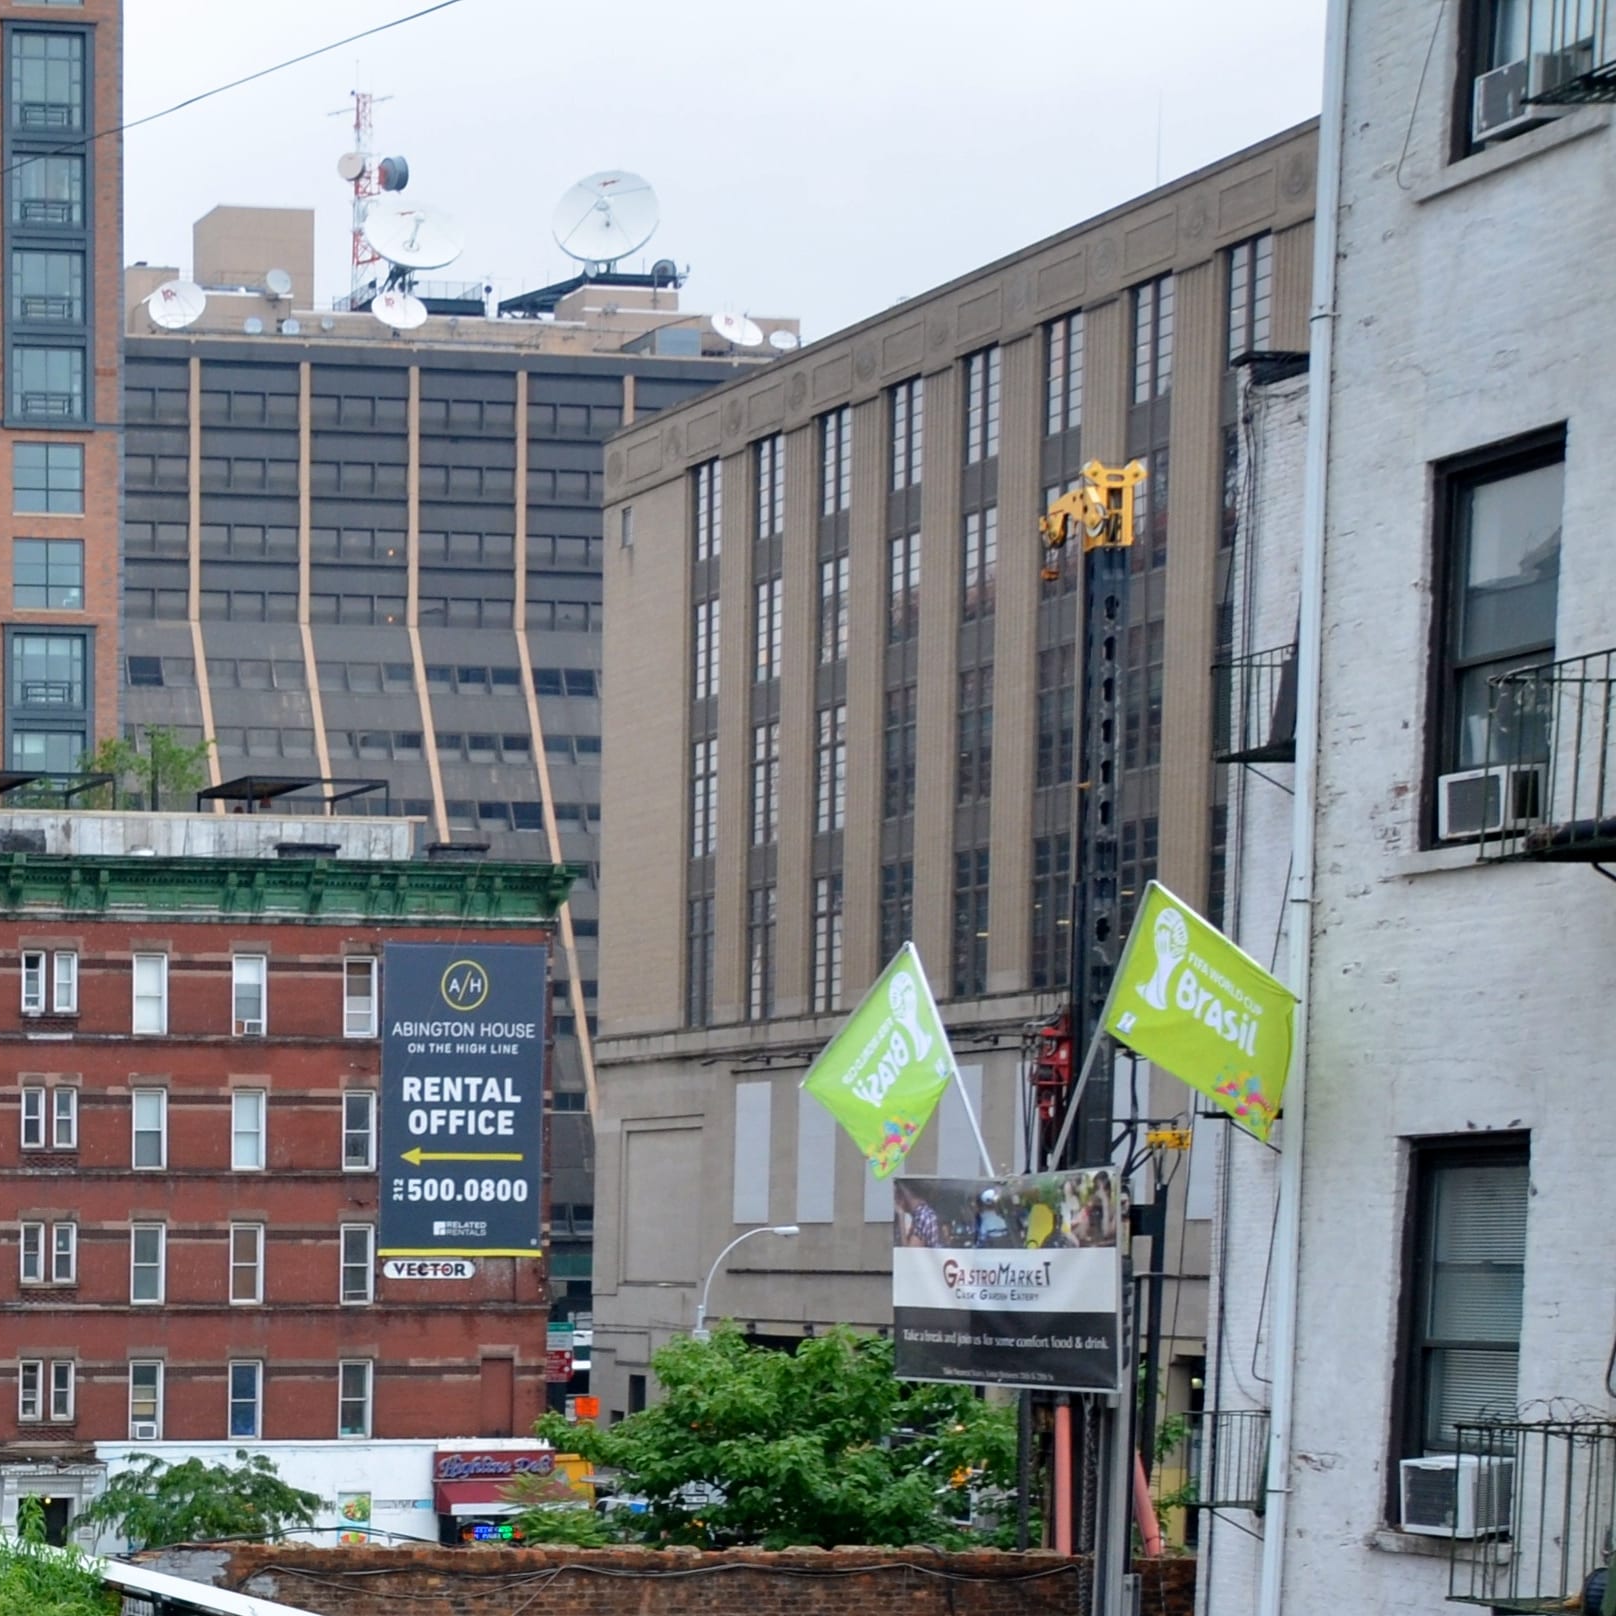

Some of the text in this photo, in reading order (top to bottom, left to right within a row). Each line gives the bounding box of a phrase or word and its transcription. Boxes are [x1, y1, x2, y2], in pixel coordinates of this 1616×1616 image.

[392, 1021, 536, 1039] ABINGTON HOUSE
[408, 1042, 519, 1055] ON THE HIGH LINE
[402, 1076, 521, 1103] RENTAL
[408, 1109, 514, 1136] OFFICE
[393, 1178, 528, 1202] 212 500.0800
[446, 1221, 487, 1229] RELATED
[446, 1229, 487, 1237] RENTALS
[393, 1263, 466, 1277] VECTOR
[1016, 1334, 1049, 1348] comfort
[1051, 1335, 1073, 1349] food
[1074, 1337, 1083, 1349] &
[1084, 1336, 1109, 1350] drink.
